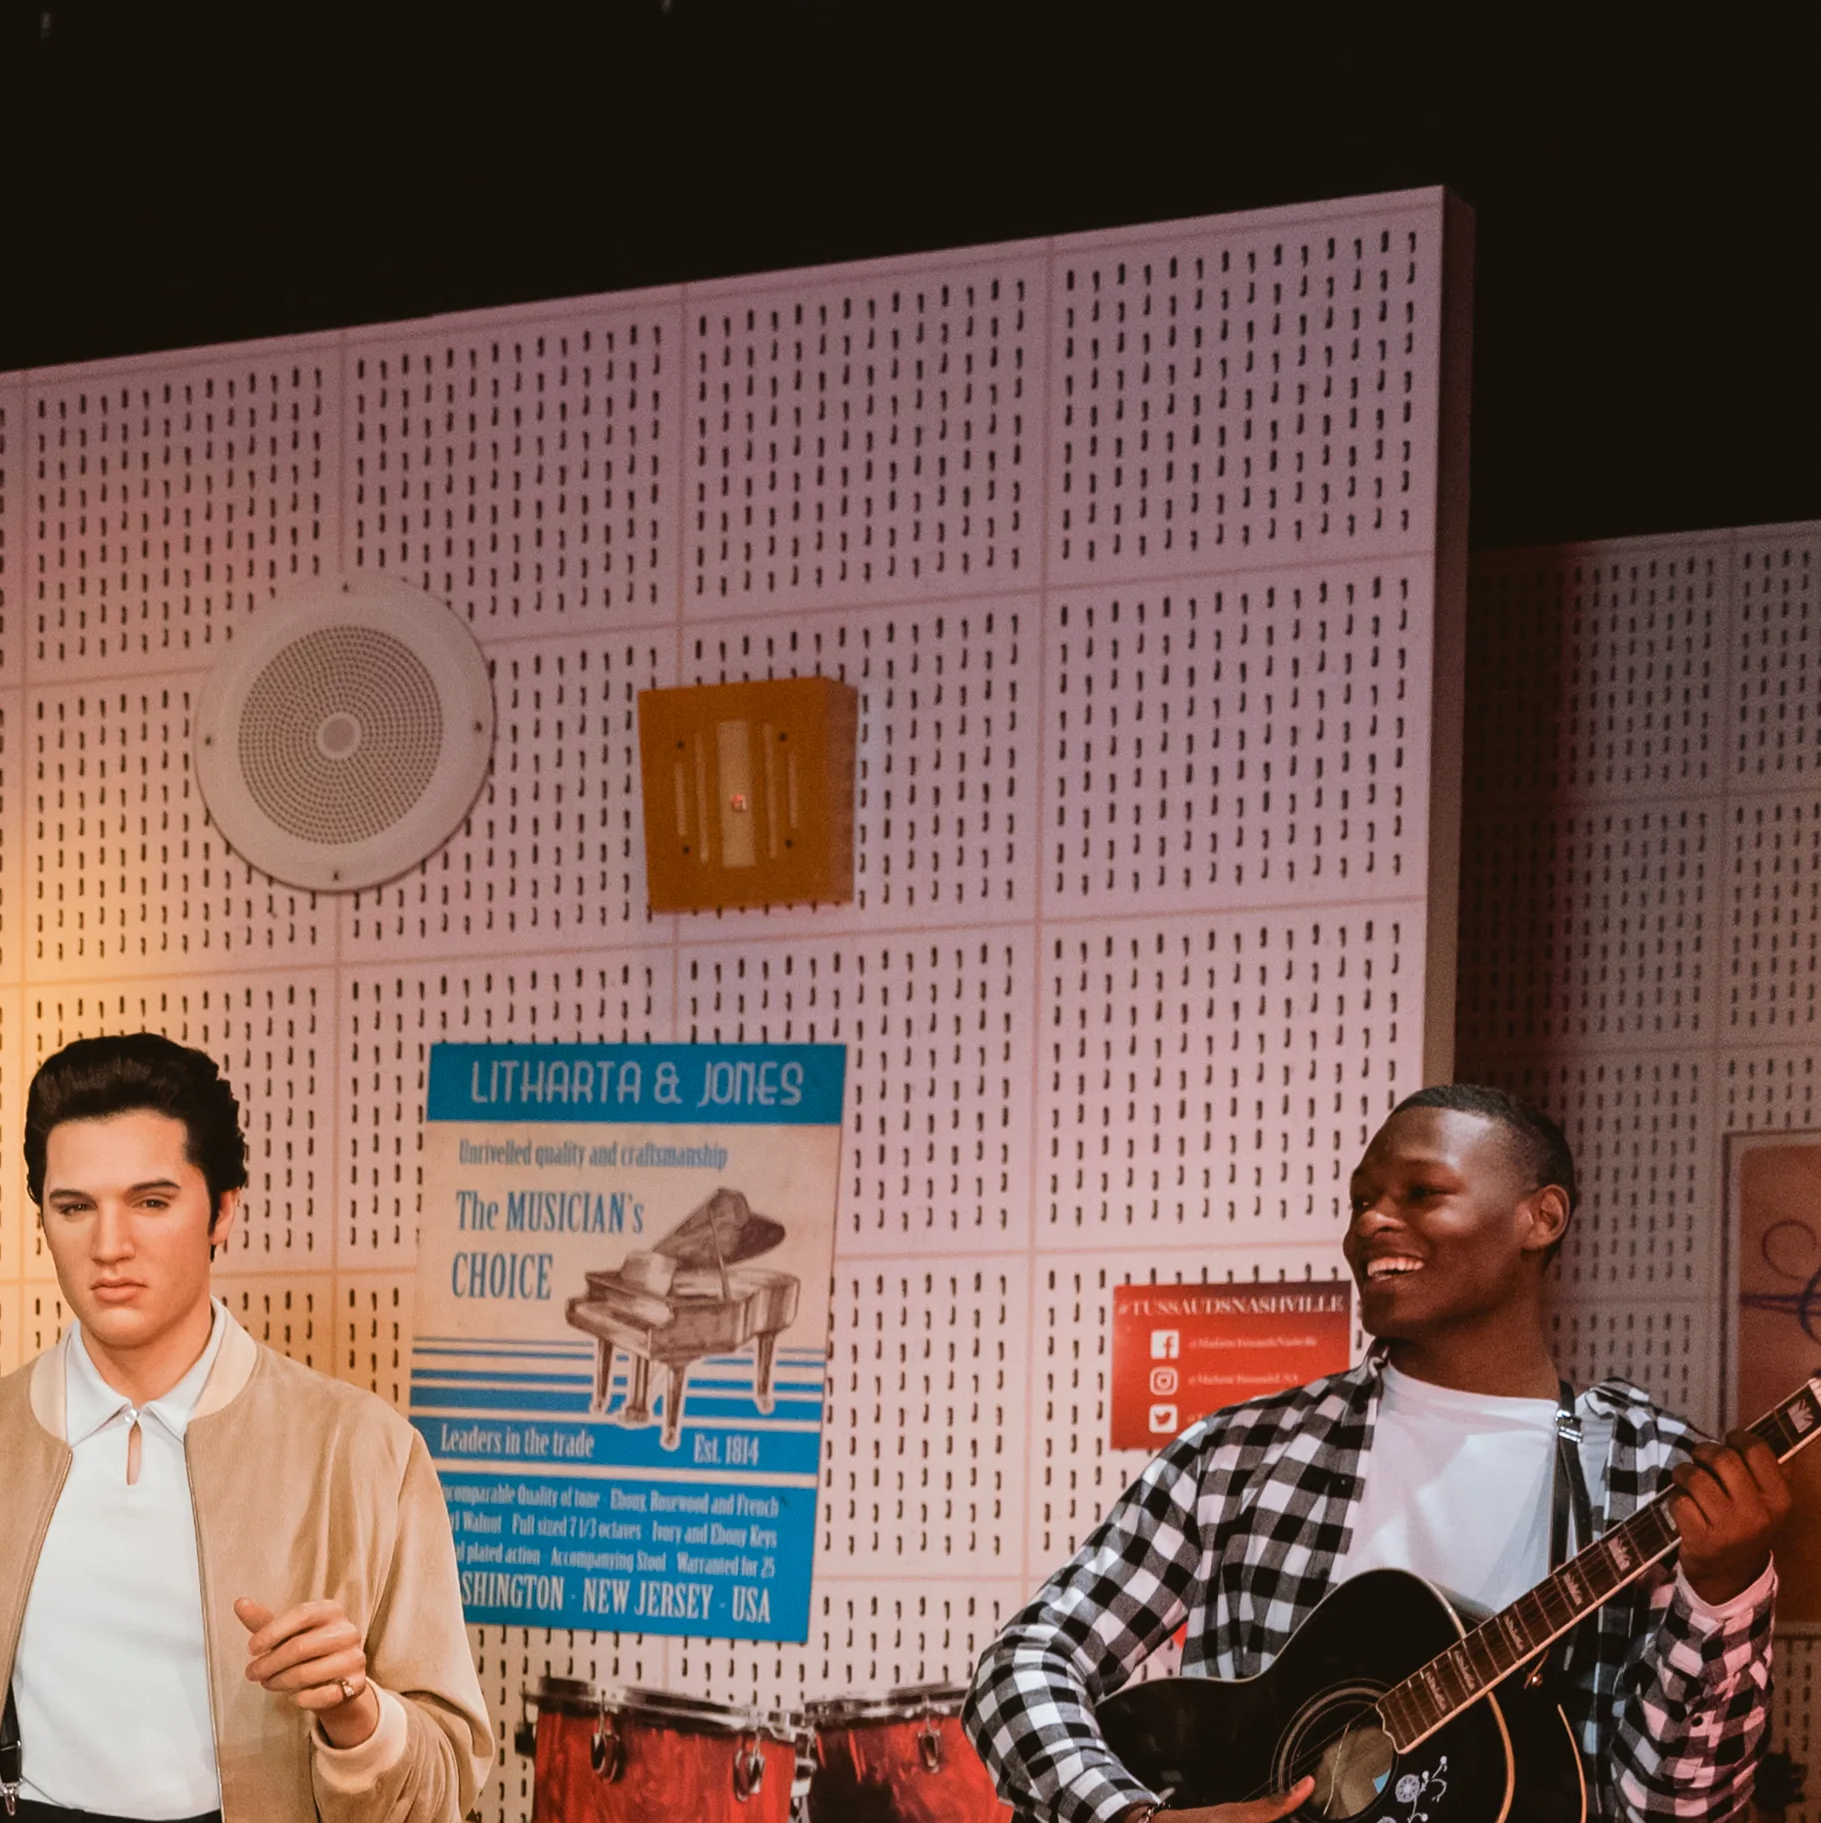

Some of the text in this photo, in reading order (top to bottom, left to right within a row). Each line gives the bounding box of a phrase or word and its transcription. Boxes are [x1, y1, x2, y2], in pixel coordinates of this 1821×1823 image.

[470, 1059, 804, 1108] LITHARTA & JONES
[536, 1139, 586, 1169] quality
[589, 1142, 617, 1167] and
[620, 1140, 728, 1172] craftsmanship
[456, 1190, 645, 1234] The MUSICIAN's
[451, 1251, 553, 1300] CHOICE
[441, 1423, 595, 1458] Leaders in the trade
[693, 1433, 759, 1466] Est. 1814
[517, 1483, 559, 1508] Quality
[560, 1486, 573, 1508] of
[574, 1490, 600, 1508] tone
[650, 1489, 709, 1514] Rosewood
[711, 1493, 734, 1515] and
[736, 1493, 779, 1518] French
[463, 1511, 502, 1534] Walnut
[512, 1513, 535, 1536] Full
[538, 1515, 567, 1537] sized
[598, 1521, 642, 1541] octaves
[652, 1520, 682, 1544] Ivory
[684, 1523, 708, 1544] and
[710, 1522, 747, 1548] Ebony
[750, 1524, 777, 1549] Keys
[467, 1542, 503, 1565] plated
[505, 1547, 540, 1566] action
[551, 1547, 634, 1573] Accompanying
[637, 1550, 666, 1572] Stool
[677, 1552, 739, 1576] Warranted
[741, 1556, 758, 1577] for
[462, 1571, 771, 1624] SHINGTON NEW JERSEY USA
